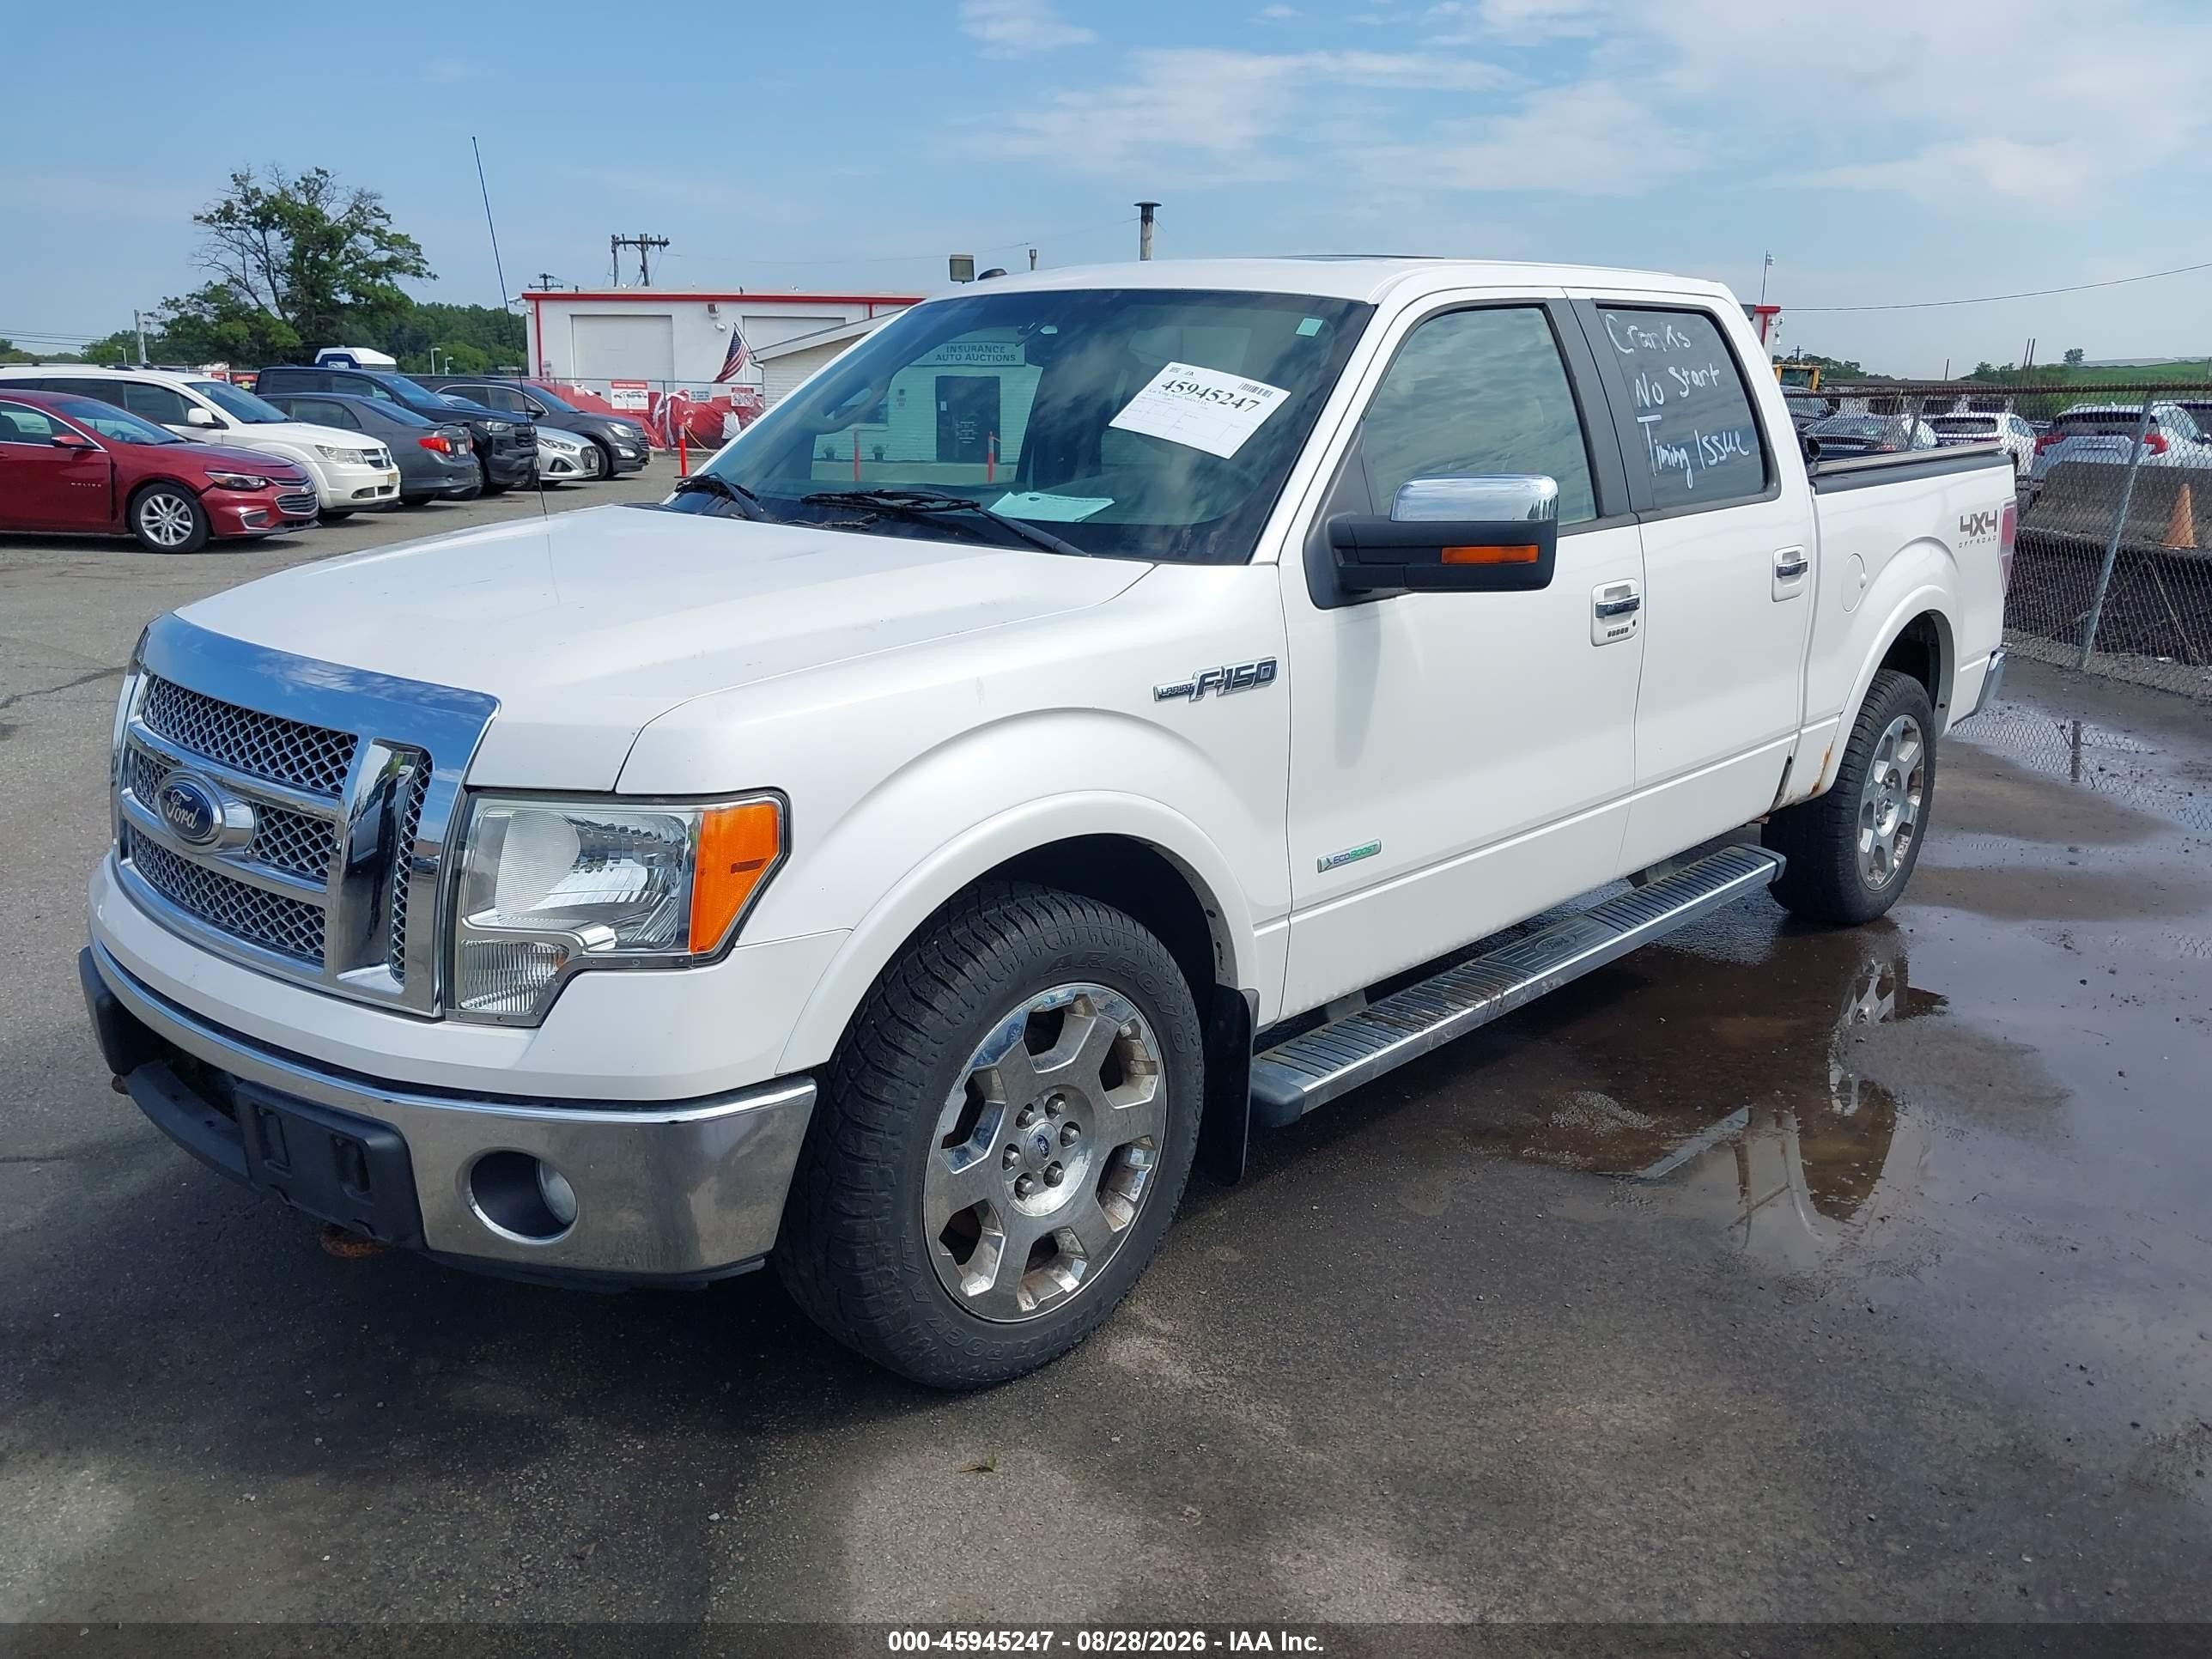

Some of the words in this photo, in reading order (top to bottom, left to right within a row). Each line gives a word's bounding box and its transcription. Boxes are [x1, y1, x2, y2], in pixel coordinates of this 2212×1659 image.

[946, 345, 1006, 354] INSURANCE
[1161, 379, 1261, 412] 45945247
[1637, 414, 1693, 489] Timing
[1192, 659, 1278, 701] F-150
[166, 788, 200, 830] Ford
[1037, 950, 1188, 1054] ARROYO
